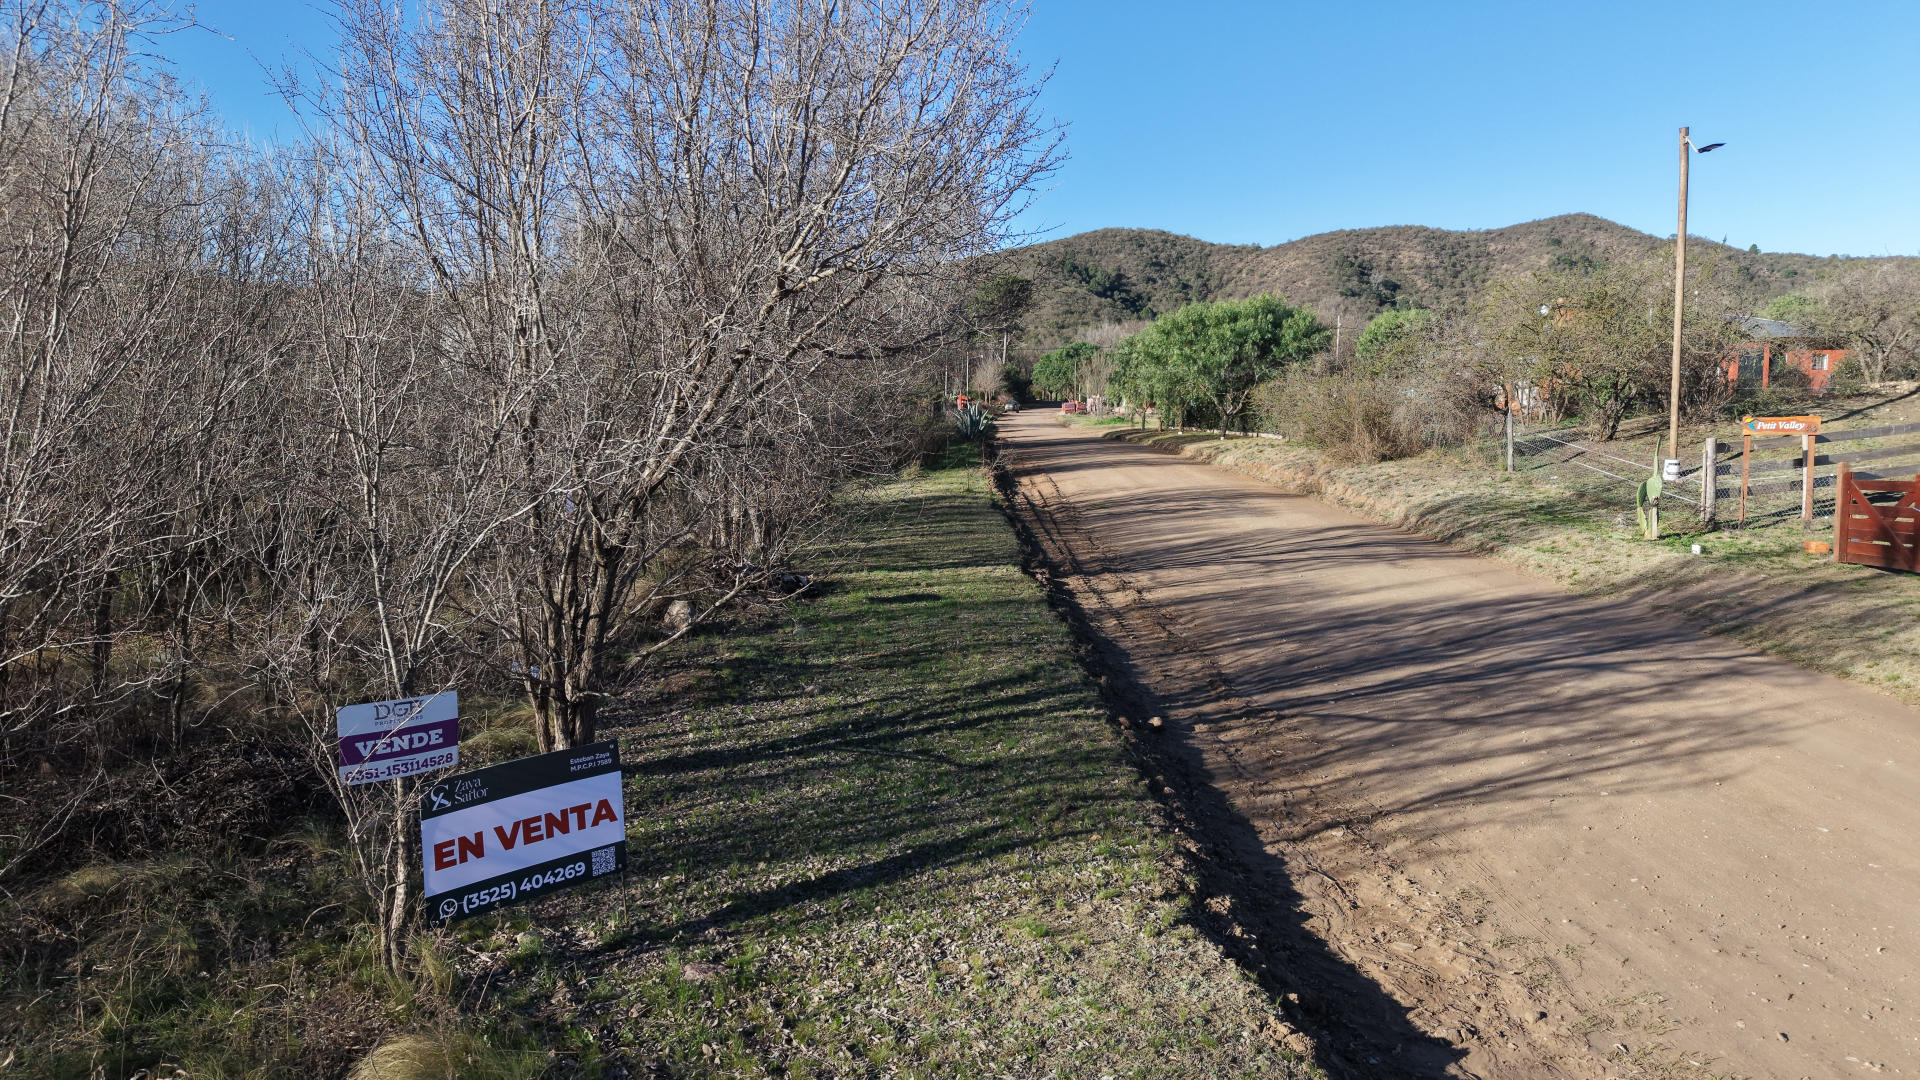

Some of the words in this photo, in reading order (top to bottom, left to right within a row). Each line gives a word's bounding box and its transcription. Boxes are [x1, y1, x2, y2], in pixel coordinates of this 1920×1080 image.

[1757, 421, 1776, 430] Petit
[1778, 421, 1805, 430] Valley
[355, 728, 444, 758] VENDE
[345, 753, 454, 781] 0351-153114528
[570, 755, 594, 765] Esteban
[595, 752, 610, 760] Zaya
[454, 778, 481, 793] Zaya
[454, 787, 489, 805] Sartor
[434, 831, 485, 871] EN
[493, 798, 618, 851] VENTA
[463, 881, 517, 914] (3525)
[520, 861, 586, 892] 404269
